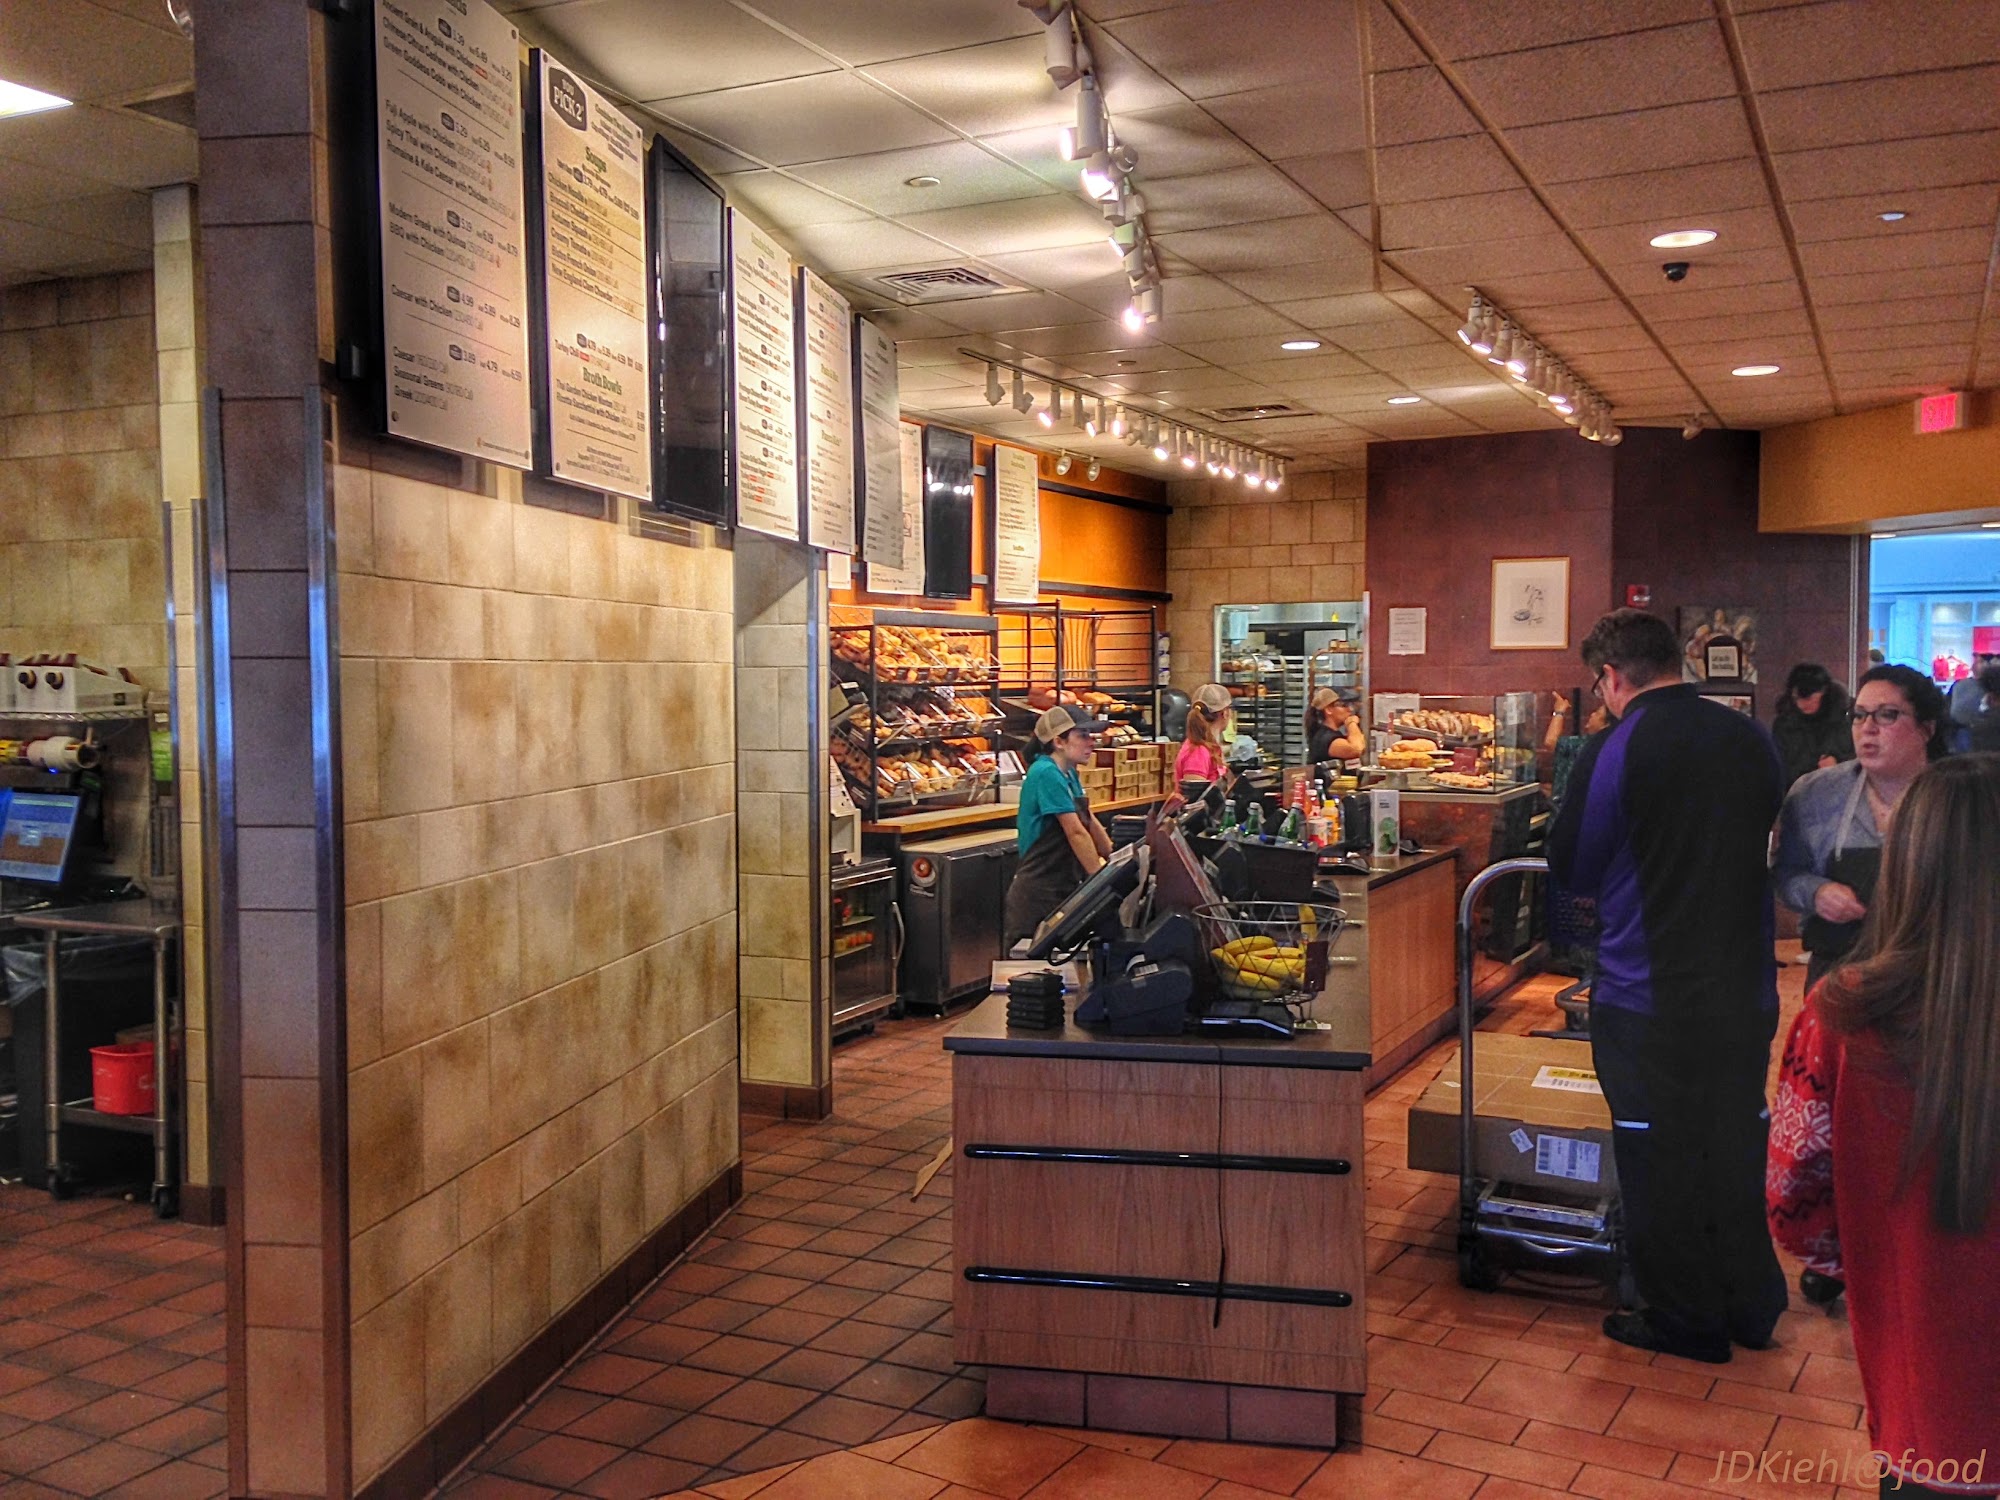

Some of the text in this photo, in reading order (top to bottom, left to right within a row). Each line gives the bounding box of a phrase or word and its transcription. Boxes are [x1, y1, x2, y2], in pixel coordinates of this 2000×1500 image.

[553, 85, 575, 117] PICK
[420, 236, 444, 257] Chicken
[415, 294, 427, 308] with
[429, 300, 452, 319] Chicken
[582, 367, 622, 395] Broth Bowls
